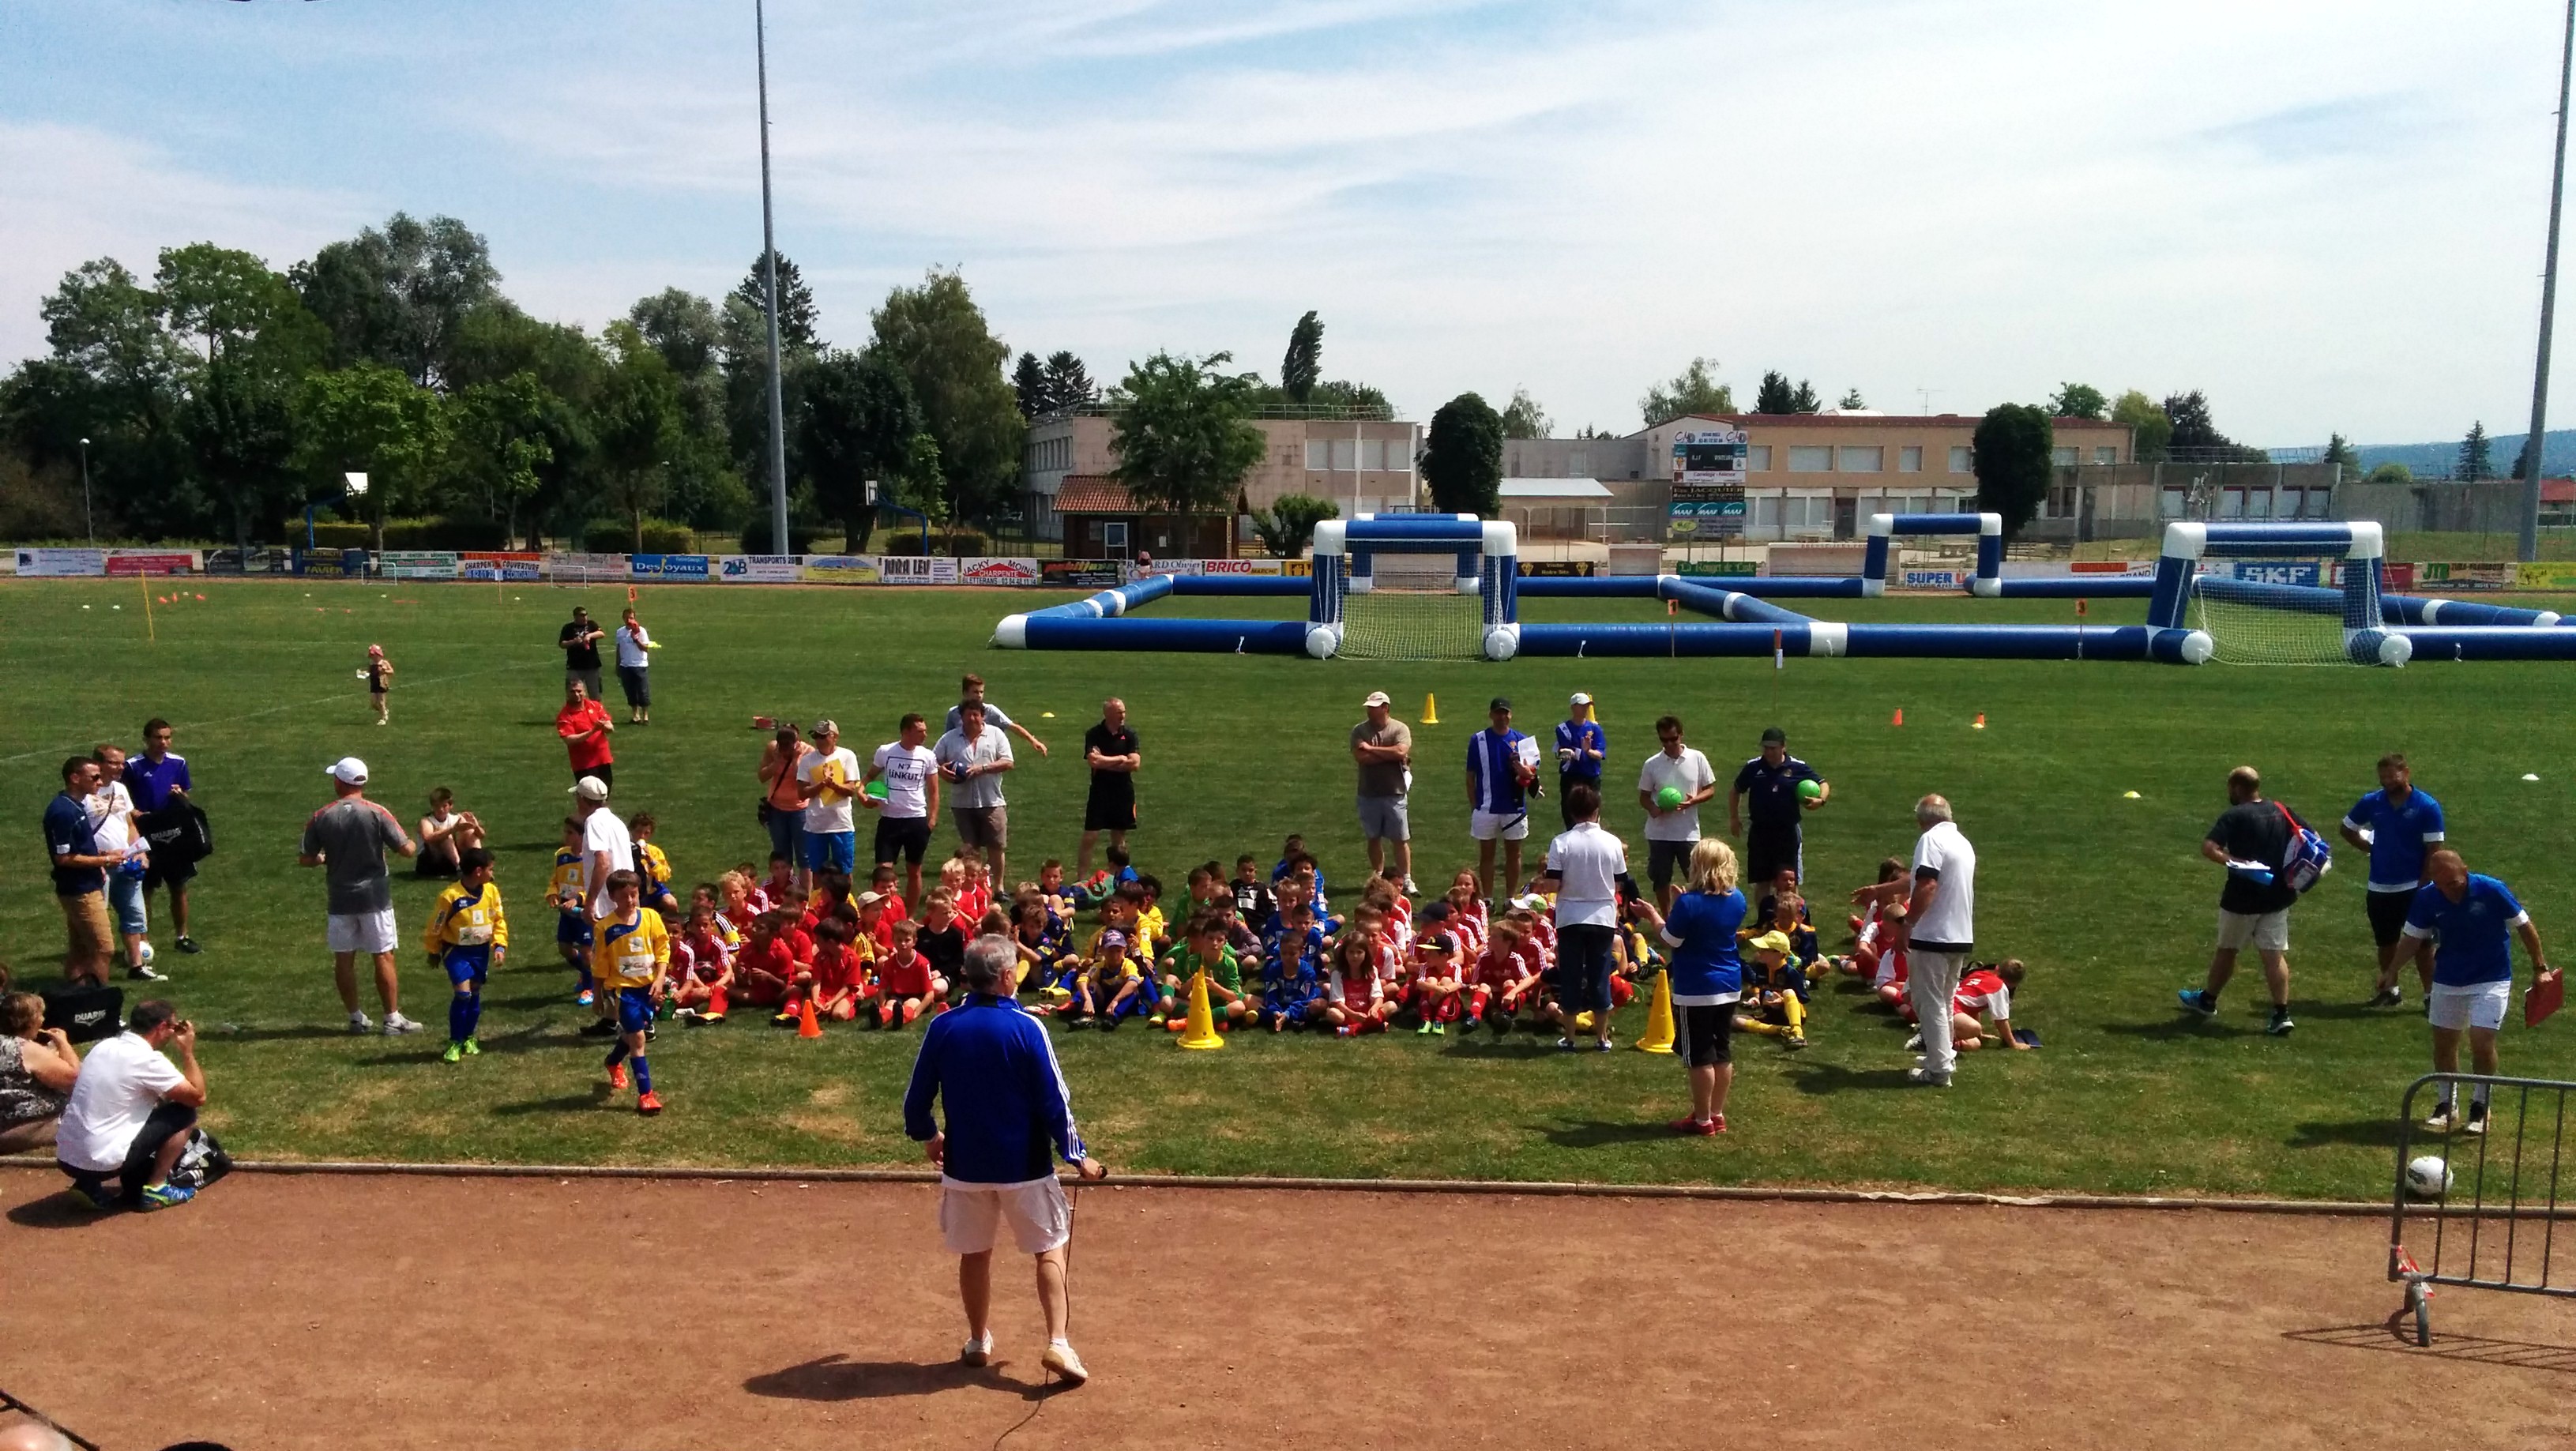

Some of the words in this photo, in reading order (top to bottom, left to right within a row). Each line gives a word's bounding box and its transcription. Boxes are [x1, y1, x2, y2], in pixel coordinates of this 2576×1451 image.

[502, 561, 540, 571] COUVERTURE
[963, 559, 989, 575] JACKY
[1008, 559, 1036, 576] MOINE
[1907, 573, 1953, 583] SUPER
[1956, 573, 1967, 584] U
[2243, 566, 2311, 585] SKF
